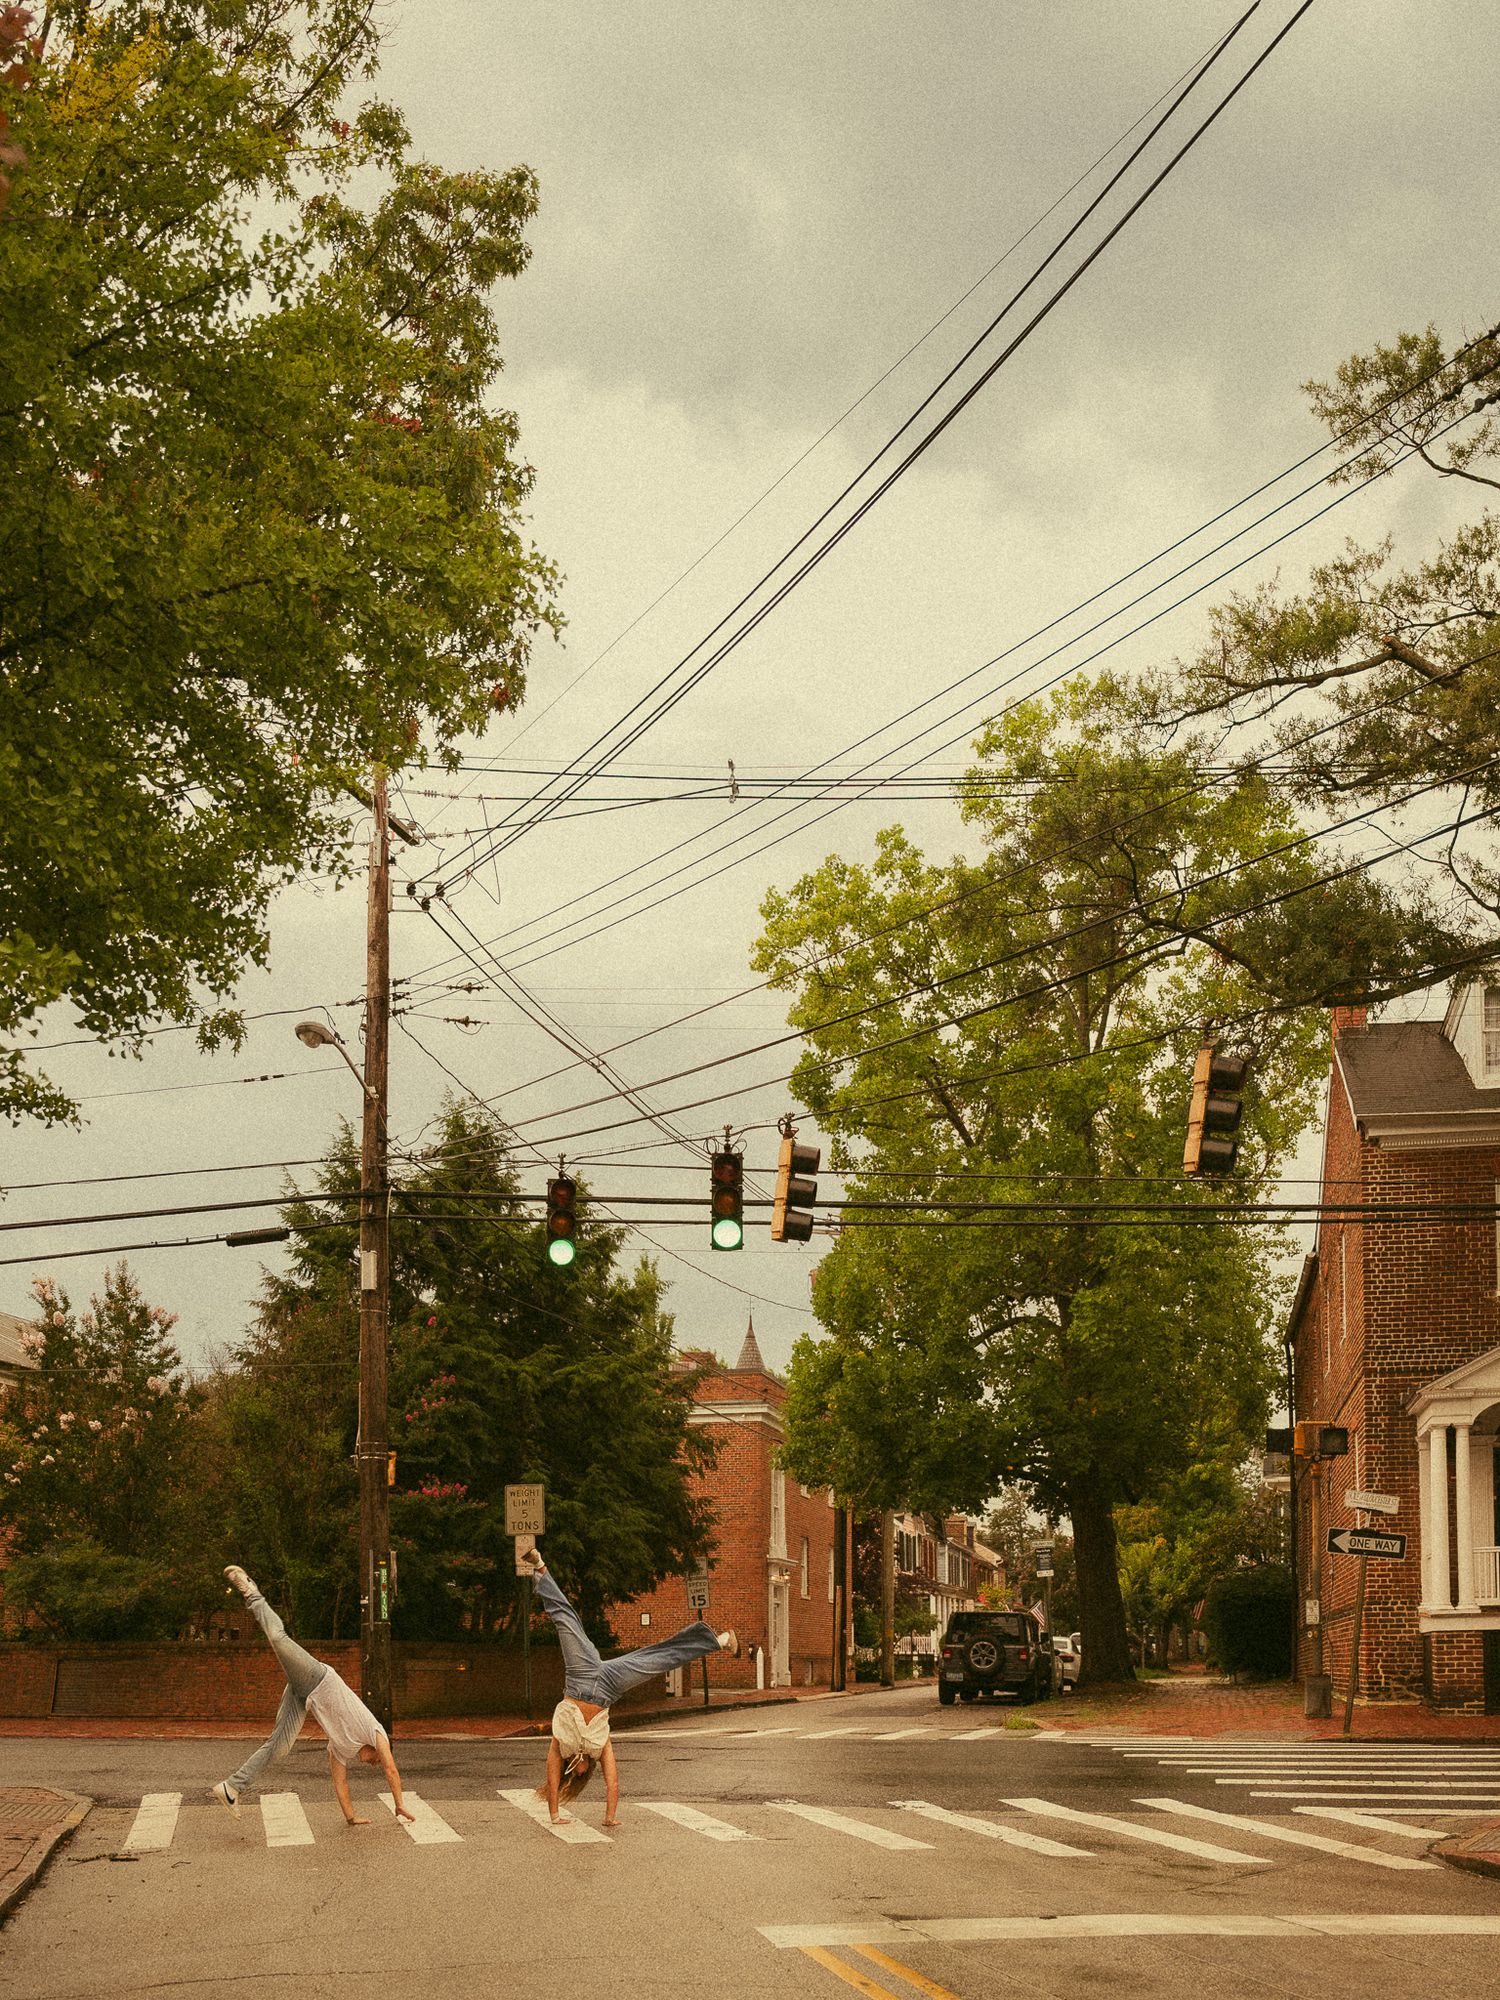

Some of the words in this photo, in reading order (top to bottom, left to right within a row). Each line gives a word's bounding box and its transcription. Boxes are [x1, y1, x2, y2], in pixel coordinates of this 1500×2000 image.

[510, 1489, 540, 1497] WEIGHT
[513, 1499, 536, 1507] LIMIT
[521, 1510, 529, 1519] 5
[511, 1520, 540, 1531] TONS
[1349, 1537, 1371, 1549] ONE
[1374, 1540, 1398, 1552] WAY
[381, 1568, 388, 1584] BE
[691, 1594, 707, 1607] 15
